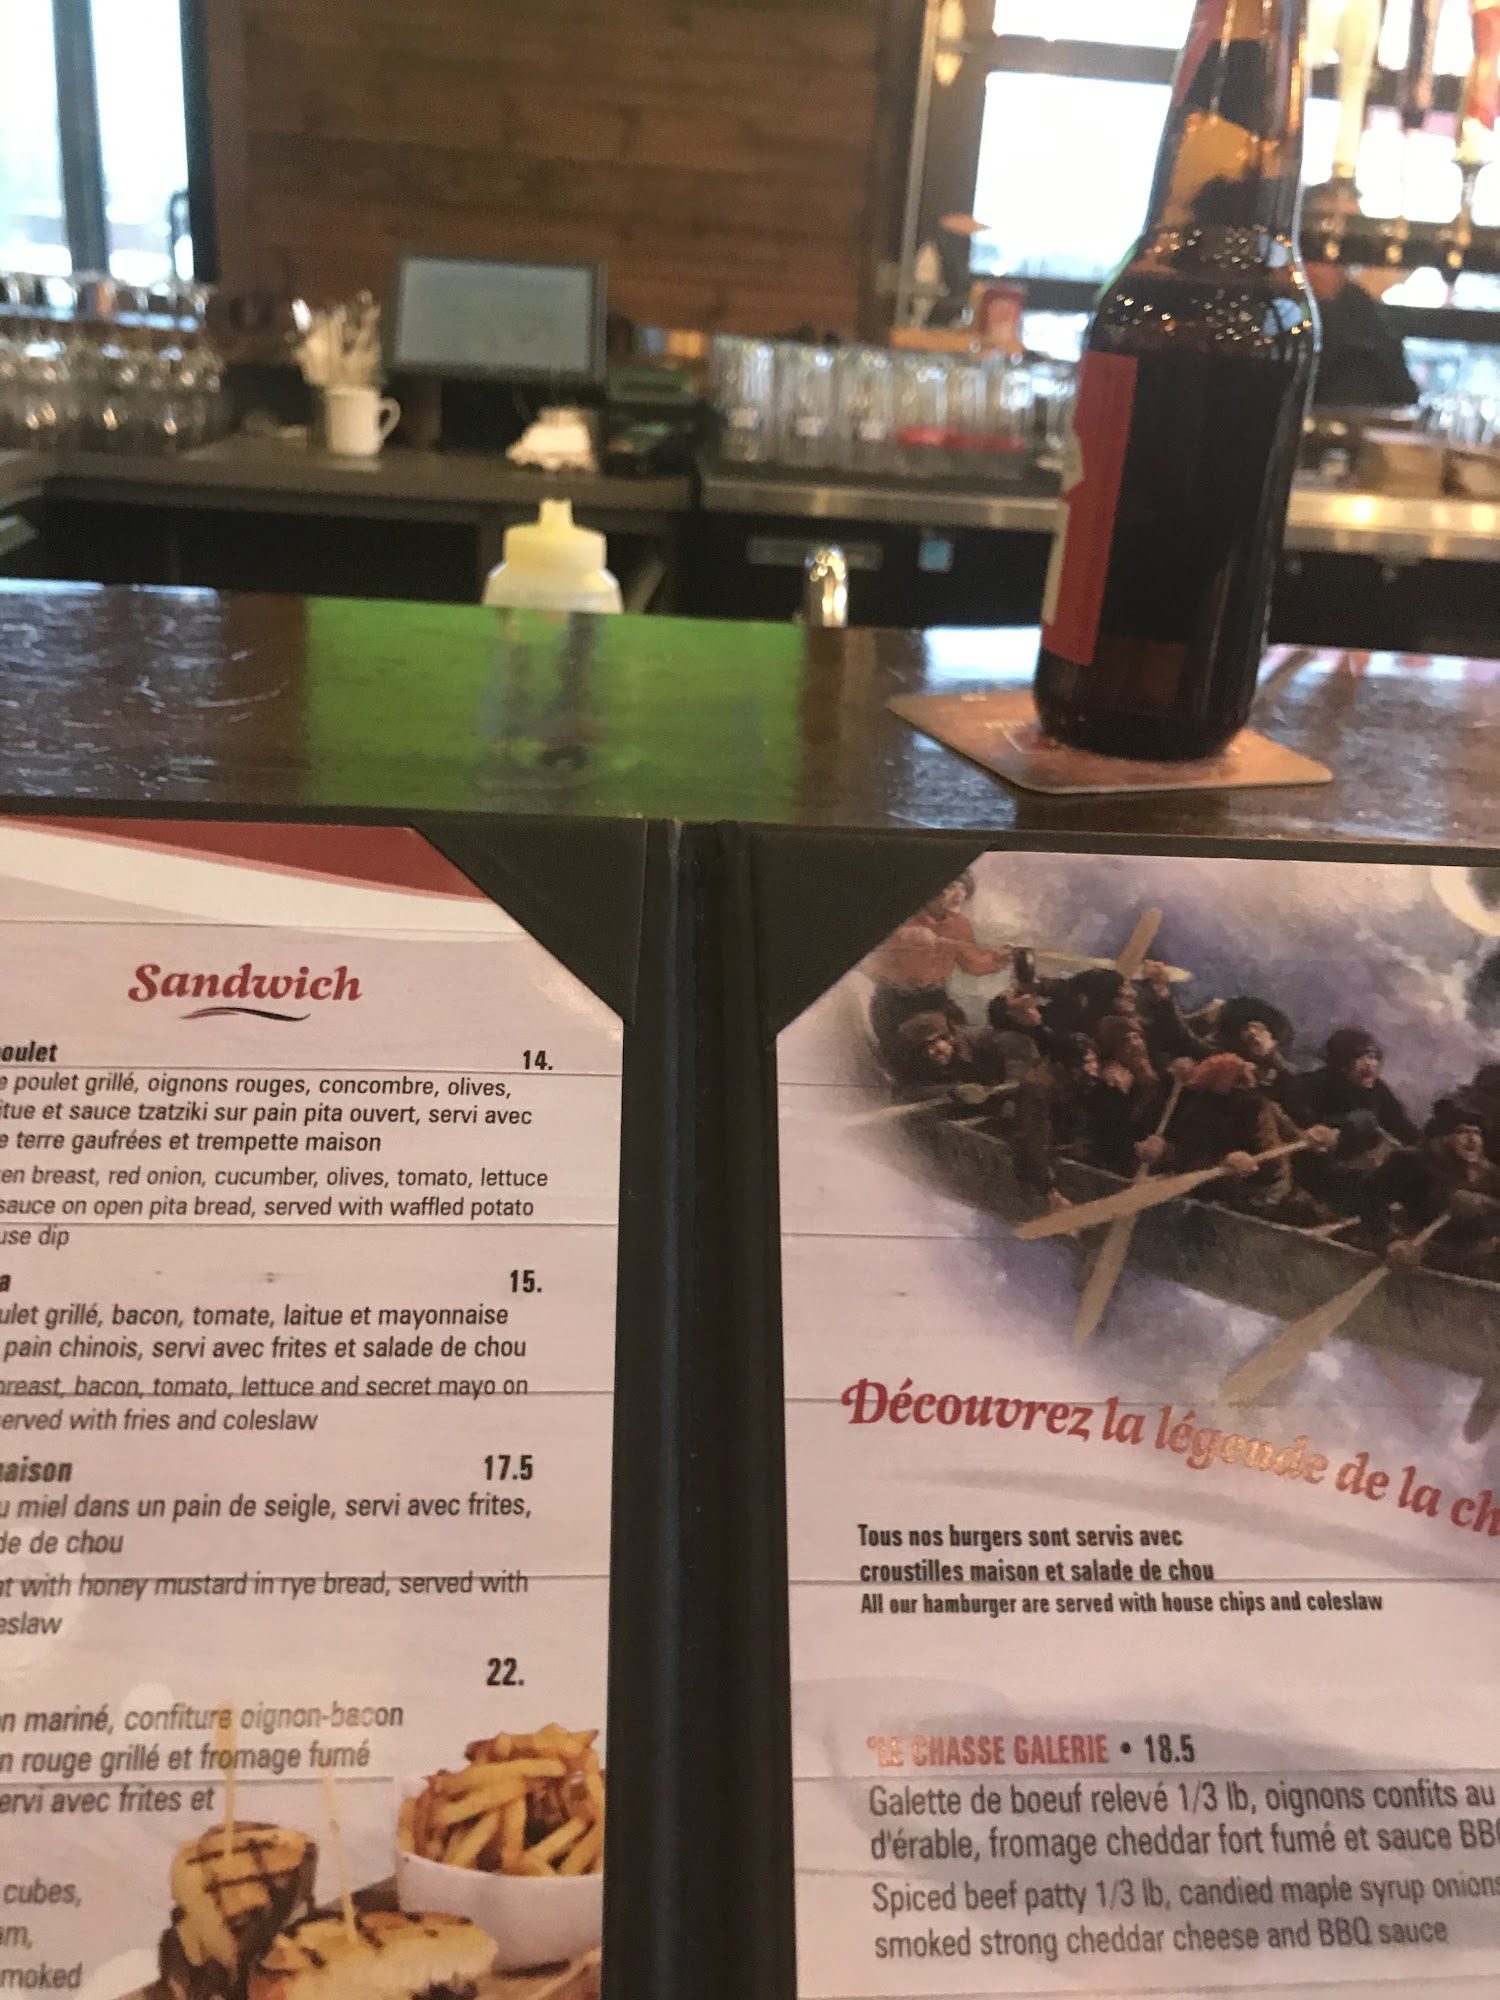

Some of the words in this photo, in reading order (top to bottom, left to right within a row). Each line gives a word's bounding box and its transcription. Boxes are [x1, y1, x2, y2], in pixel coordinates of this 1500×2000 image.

[128, 963, 362, 1002] Sandwich
[523, 1050, 553, 1070] 14.
[13, 1072, 79, 1095] poulet
[85, 1072, 138, 1096] grillé,
[148, 1078, 228, 1096] oignons
[236, 1079, 310, 1097] rouges,
[319, 1076, 439, 1097] concombre,
[448, 1077, 510, 1099] olives,
[42, 1103, 63, 1120] et
[69, 1105, 131, 1120] sauce
[139, 1101, 208, 1121] tzatziki
[214, 1107, 248, 1121] sur
[253, 1103, 297, 1126] pain
[304, 1103, 342, 1126] pita
[350, 1106, 420, 1129] ouvert,
[429, 1105, 477, 1123] servi
[485, 1110, 532, 1124] avec
[17, 1131, 64, 1149] terre
[72, 1129, 161, 1154] gaufrées
[169, 1133, 189, 1150] et
[197, 1134, 298, 1155] trempette
[306, 1132, 381, 1151] maison
[32, 1165, 99, 1187] breast,
[109, 1165, 141, 1184] red
[147, 1170, 206, 1187] onion,
[215, 1166, 318, 1188] cucumber,
[327, 1167, 388, 1188] olives,
[398, 1169, 472, 1188] tomato,
[481, 1168, 548, 1186] lettuce
[0, 1199, 56, 1214] sauce
[62, 1200, 87, 1214] on
[93, 1200, 143, 1219] open
[149, 1196, 187, 1219] pita
[194, 1196, 255, 1218] bread,
[264, 1197, 332, 1215] served
[339, 1196, 382, 1215] with
[390, 1196, 464, 1216] waffled
[471, 1199, 533, 1220] potato
[38, 1223, 69, 1250] dip
[511, 1270, 541, 1293] 15.
[45, 1303, 103, 1330] grillé,
[112, 1304, 183, 1328] bacon,
[194, 1306, 274, 1328] tomate,
[284, 1304, 343, 1325] laitue
[350, 1307, 371, 1325] et
[379, 1309, 508, 1330] mayonnaise
[3, 1340, 52, 1362] pain
[59, 1335, 143, 1361] chinois,
[152, 1342, 205, 1358] servi
[213, 1342, 264, 1358] avec
[272, 1336, 327, 1358] frites
[335, 1339, 356, 1357] et
[363, 1336, 433, 1357] salade
[441, 1339, 466, 1357] de
[474, 1339, 526, 1357] chou
[152, 1378, 232, 1399] tomato,
[241, 1376, 314, 1397] lettuce
[320, 1376, 359, 1397] and
[366, 1377, 431, 1397] secret
[438, 1380, 496, 1400] mayo
[502, 1380, 528, 1395] on
[70, 1408, 117, 1430] with
[124, 1408, 170, 1430] fries
[177, 1409, 216, 1430] and
[223, 1409, 318, 1430] coleslaw
[842, 1378, 1092, 1442] Découvrez
[1102, 1396, 1145, 1445] la
[1154, 1405, 1329, 1485] légende
[1335, 1452, 1390, 1501] de
[1398, 1466, 1442, 1517] la
[485, 1455, 533, 1480] 17.5
[17, 1494, 68, 1518] miel
[74, 1494, 130, 1517] dans
[137, 1499, 165, 1517] un
[172, 1499, 221, 1523] pain
[229, 1493, 256, 1517] de
[264, 1493, 335, 1522] seigle,
[346, 1493, 400, 1516] servi
[408, 1499, 460, 1516] avec
[468, 1492, 531, 1518] frites,
[29, 1531, 58, 1554] de
[66, 1530, 123, 1554] chou
[858, 1524, 903, 1546] Tous
[909, 1530, 943, 1546] nos
[949, 1524, 1022, 1552] burgers
[1028, 1528, 1070, 1547] sont
[1076, 1524, 1133, 1546] servis
[1140, 1530, 1183, 1546] avec
[860, 1559, 964, 1583] croustilles
[970, 1558, 1041, 1584] maison
[1045, 1562, 1064, 1583] et
[1071, 1559, 1134, 1583] salade
[1139, 1559, 1162, 1583] de
[1168, 1558, 1213, 1583] chou
[861, 1593, 883, 1613] All
[890, 1599, 918, 1614] our
[923, 1593, 1016, 1618] hamburger
[1022, 1598, 1049, 1613] are
[1056, 1593, 1114, 1613] served
[1119, 1592, 1157, 1612] with
[1162, 1592, 1213, 1612] house
[1219, 1591, 1265, 1616] chips
[1271, 1591, 1301, 1611] and
[1307, 1591, 1382, 1611] coleslaw
[487, 1658, 524, 1686] 22.
[24, 1704, 112, 1734] mariné,
[21, 1752, 92, 1779] rouge
[100, 1743, 160, 1778] grillé
[168, 1747, 193, 1770] et
[200, 1746, 301, 1775] fromage
[309, 1743, 370, 1768] fumé
[912, 1735, 1006, 1767] CHASSE
[1013, 1734, 1109, 1765] GALERIE
[1145, 1733, 1195, 1764] 18.5
[50, 1792, 110, 1813] avec
[118, 1781, 182, 1812] frites
[190, 1787, 215, 1811] et
[869, 1785, 961, 1817] Galette
[971, 1784, 1002, 1814] de
[1010, 1782, 1082, 1814] boeuf
[1091, 1781, 1168, 1813] relevé
[1178, 1780, 1217, 1813] 1/3
[1226, 1780, 1256, 1814] lb,
[1265, 1780, 1366, 1818] oignons
[1373, 1778, 1459, 1809] confits
[1465, 1785, 1495, 1807] au
[871, 1828, 980, 1862] d'érable,
[989, 1826, 1096, 1865] fromage
[1107, 1824, 1211, 1856] cheddar
[1218, 1823, 1264, 1854] fort
[1270, 1821, 1336, 1853] fumé
[1344, 1826, 1370, 1851] et
[1376, 1823, 1452, 1851] sauce
[3, 1877, 81, 1907] cubes,
[872, 1881, 956, 1918] Spiced
[964, 1880, 1017, 1910] beef
[1025, 1883, 1086, 1916] patty
[1096, 1878, 1135, 1910] 1/3
[1142, 1877, 1170, 1910] lb,
[1180, 1876, 1274, 1906] candied
[1281, 1874, 1352, 1909] maple
[1359, 1879, 1425, 1908] syrup
[875, 1927, 971, 1959] smoked
[980, 1926, 1059, 1963] strong
[1066, 1924, 1164, 1954] cheddar
[1174, 1921, 1259, 1951] cheese
[1267, 1919, 1311, 1949] and
[1317, 1916, 1373, 1947] BBQ
[1378, 1921, 1449, 1945] sauce
